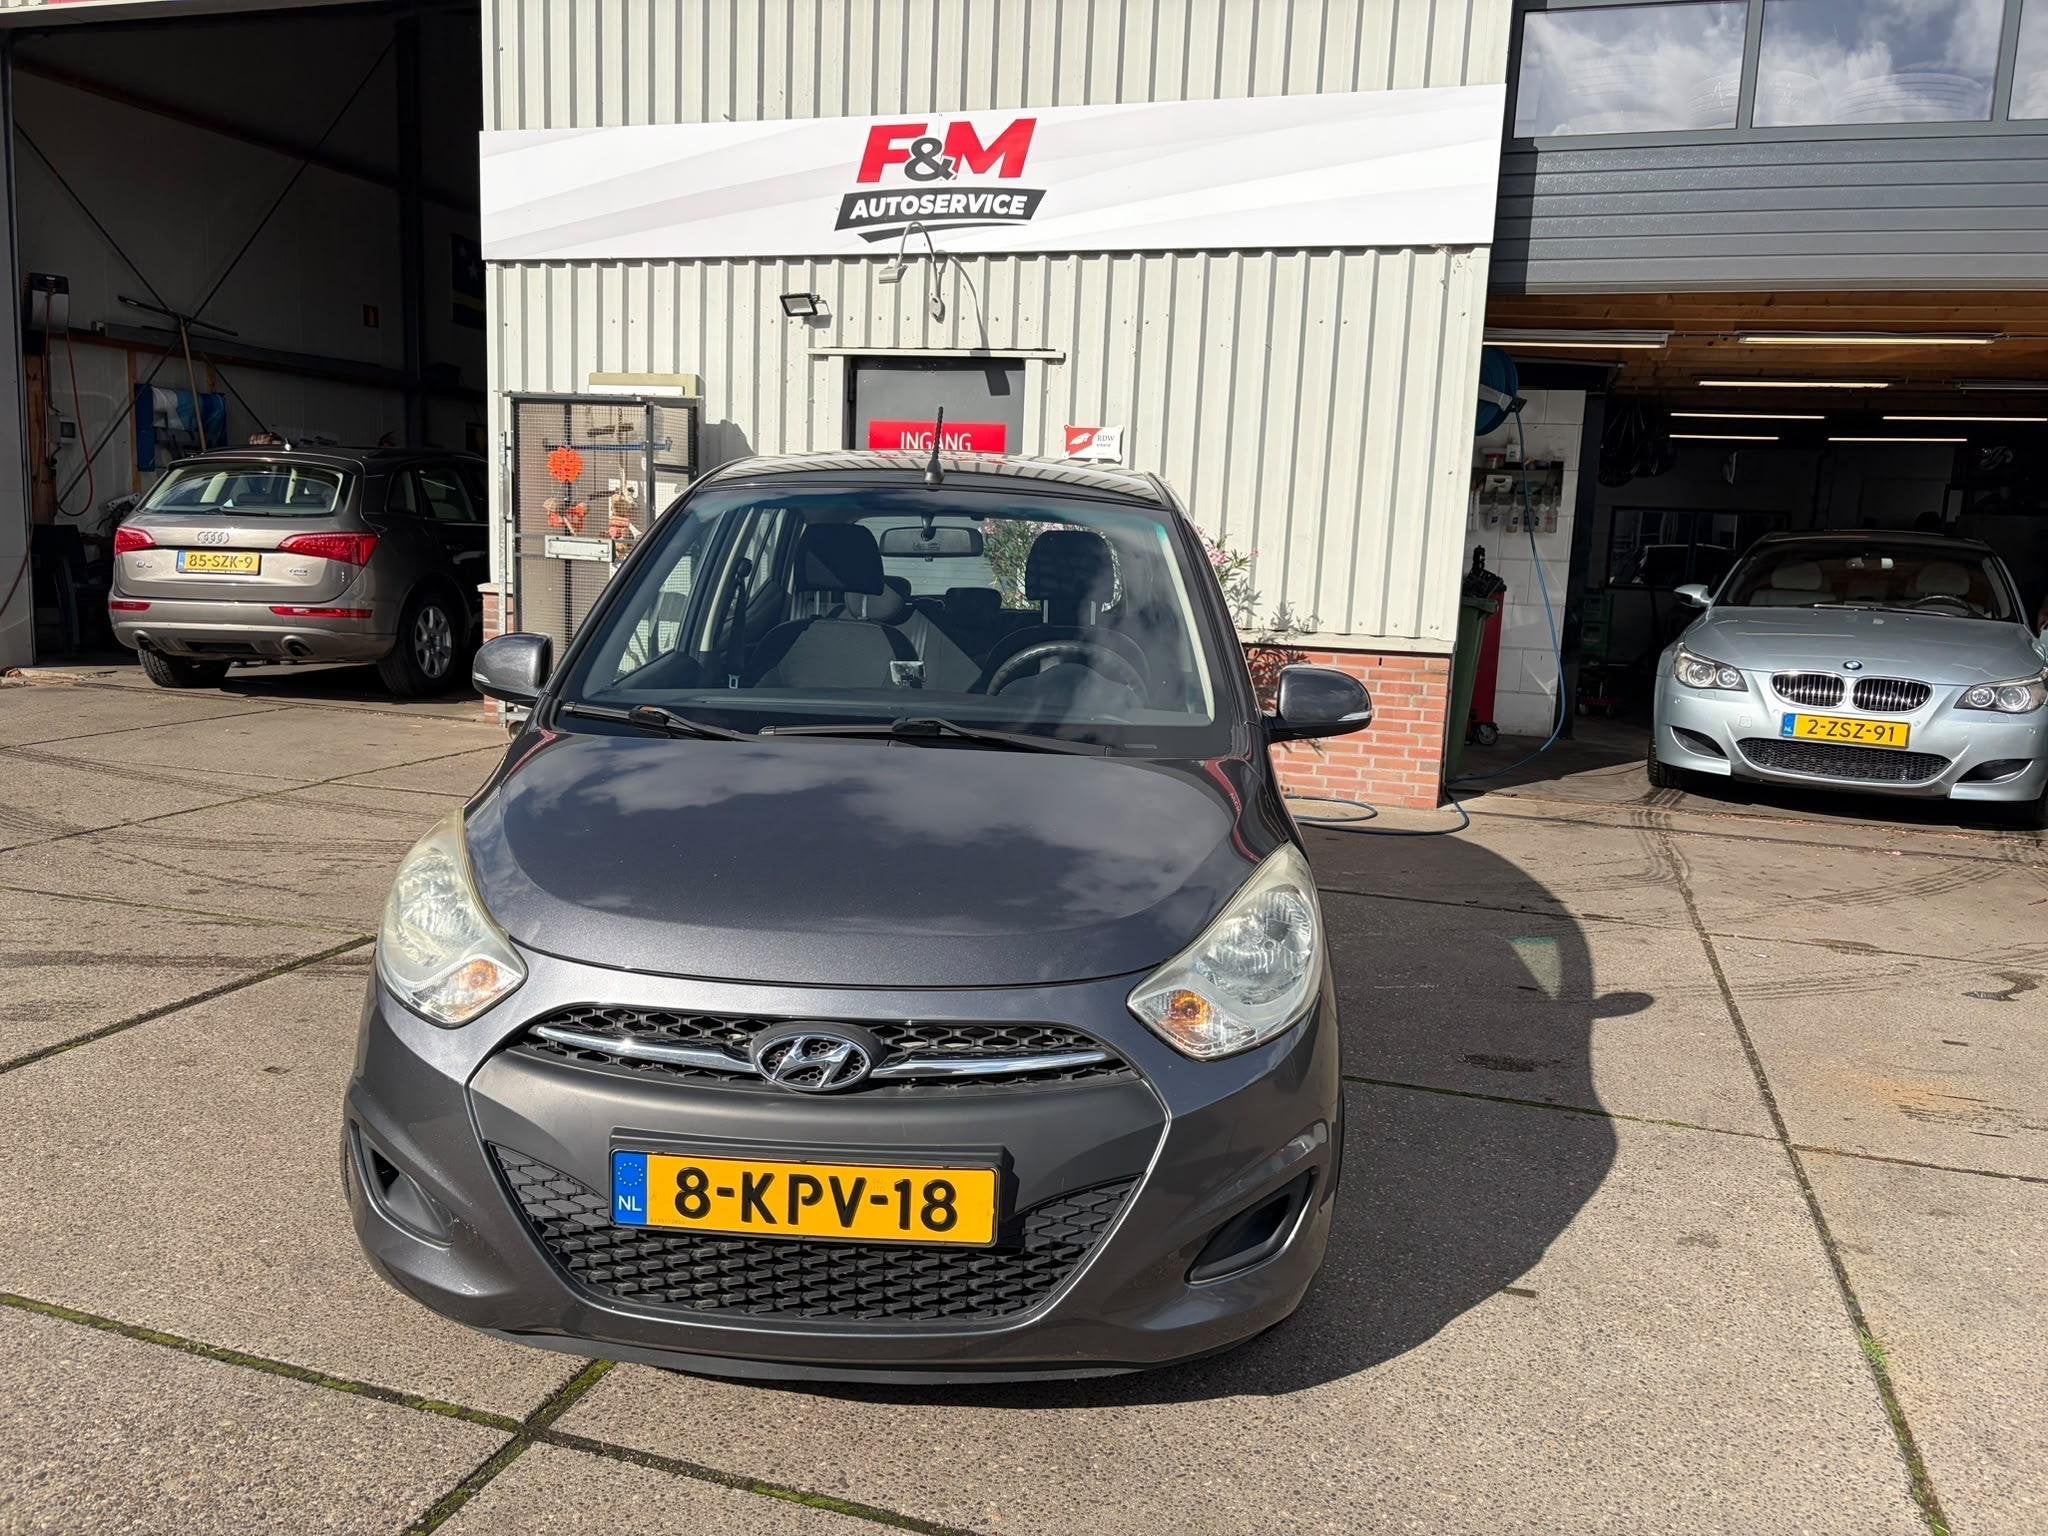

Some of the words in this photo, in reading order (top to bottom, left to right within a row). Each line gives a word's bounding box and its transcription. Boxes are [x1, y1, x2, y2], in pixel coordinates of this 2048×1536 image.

[856, 117, 1037, 184] F&M
[849, 193, 1028, 220] AUTOSERVICE
[1097, 434, 1115, 442] RDW
[188, 554, 254, 569] 85-SZK-9
[1807, 720, 1896, 742] 2-ZSZ-91
[618, 1196, 642, 1212] NL
[674, 1166, 959, 1233] 8-KPV-18
